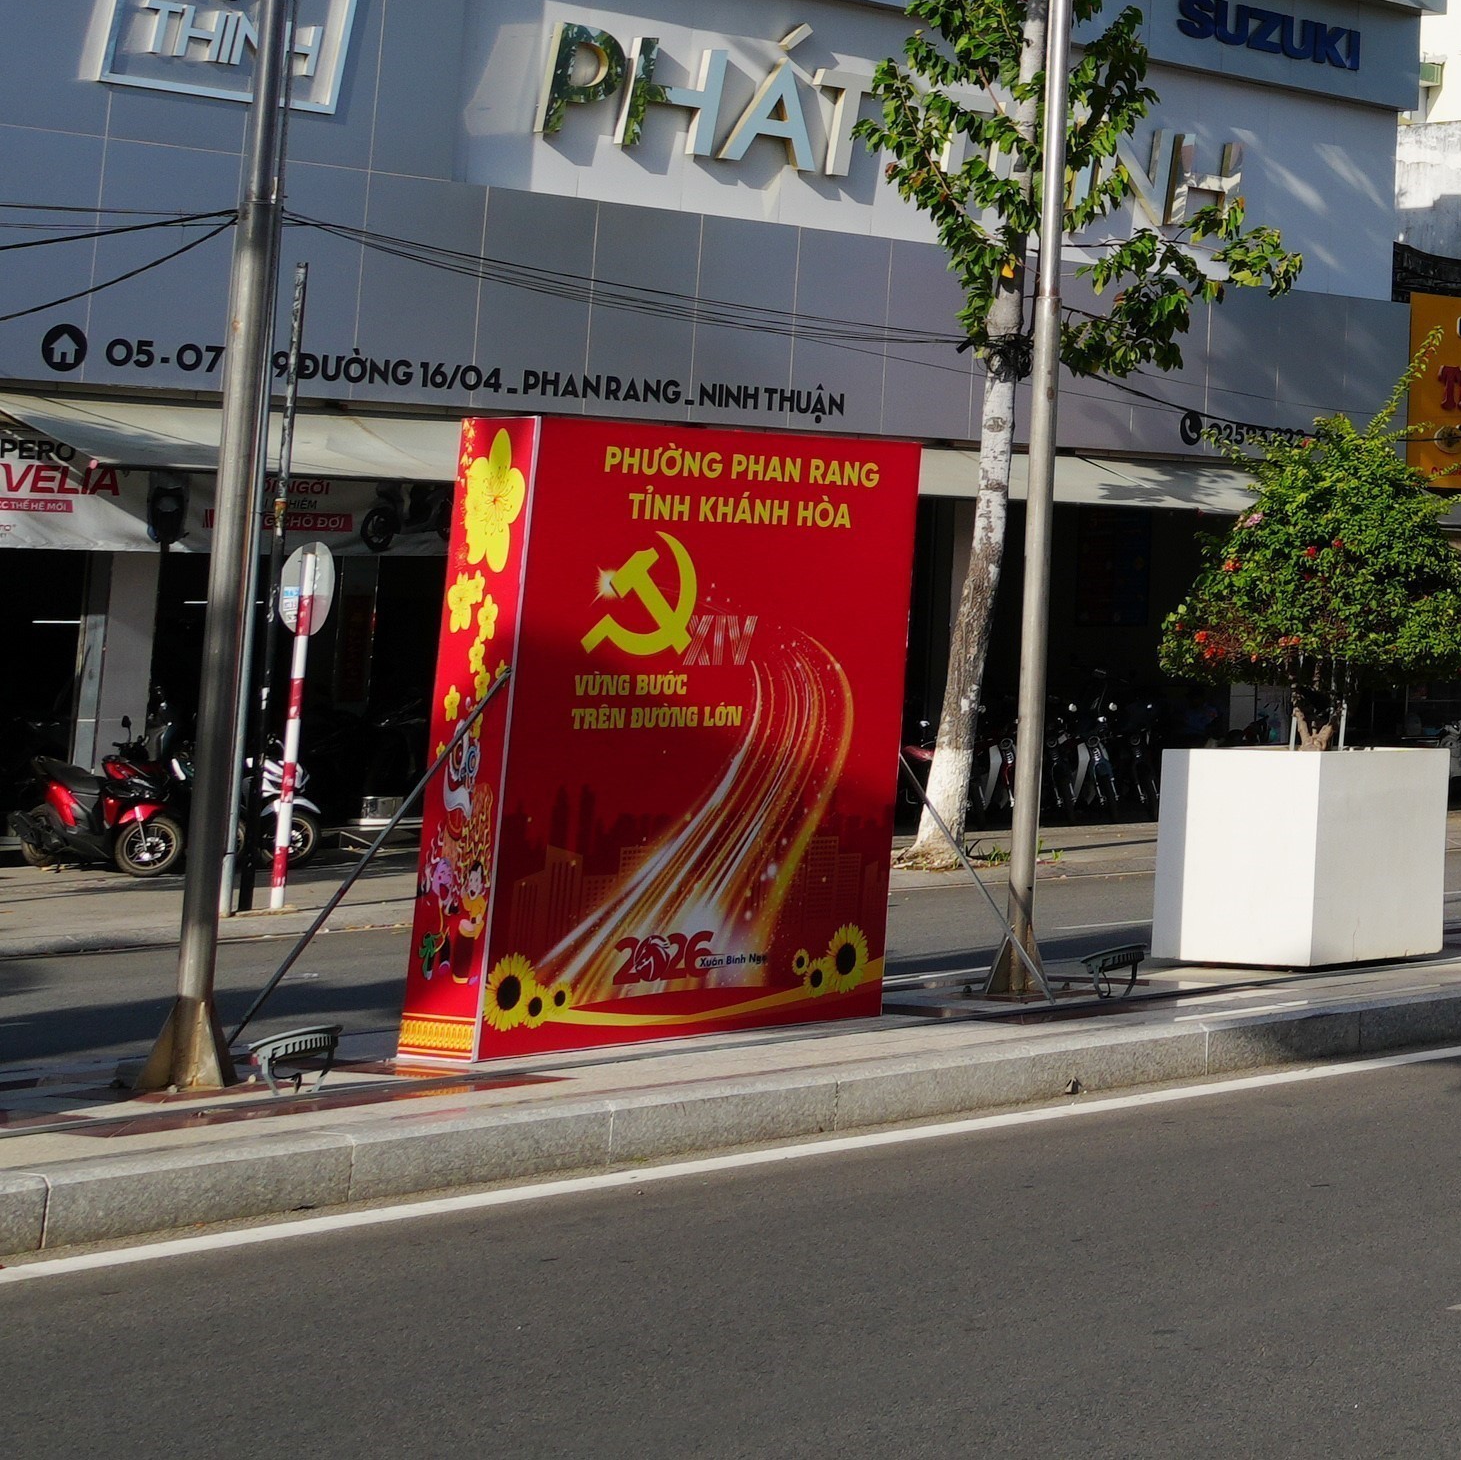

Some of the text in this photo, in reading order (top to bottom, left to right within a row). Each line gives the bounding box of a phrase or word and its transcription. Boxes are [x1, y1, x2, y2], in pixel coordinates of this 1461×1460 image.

[533, 22, 885, 177] PHÁT
[106, 339, 845, 423] 05 07 ĐƯỜNG 16/04 PHAN RANG NINH THUẬN
[0, 463, 120, 496] VELIA
[604, 443, 880, 488] PHƯỜNG PHAN RANG
[629, 484, 852, 529] TỈNH KHÁNH HÒA
[682, 615, 758, 666] XIV
[635, 670, 688, 696] BƯỚC
[571, 702, 743, 730] TRÊN ĐƯỜNG LỚN
[612, 930, 714, 986] 2026
